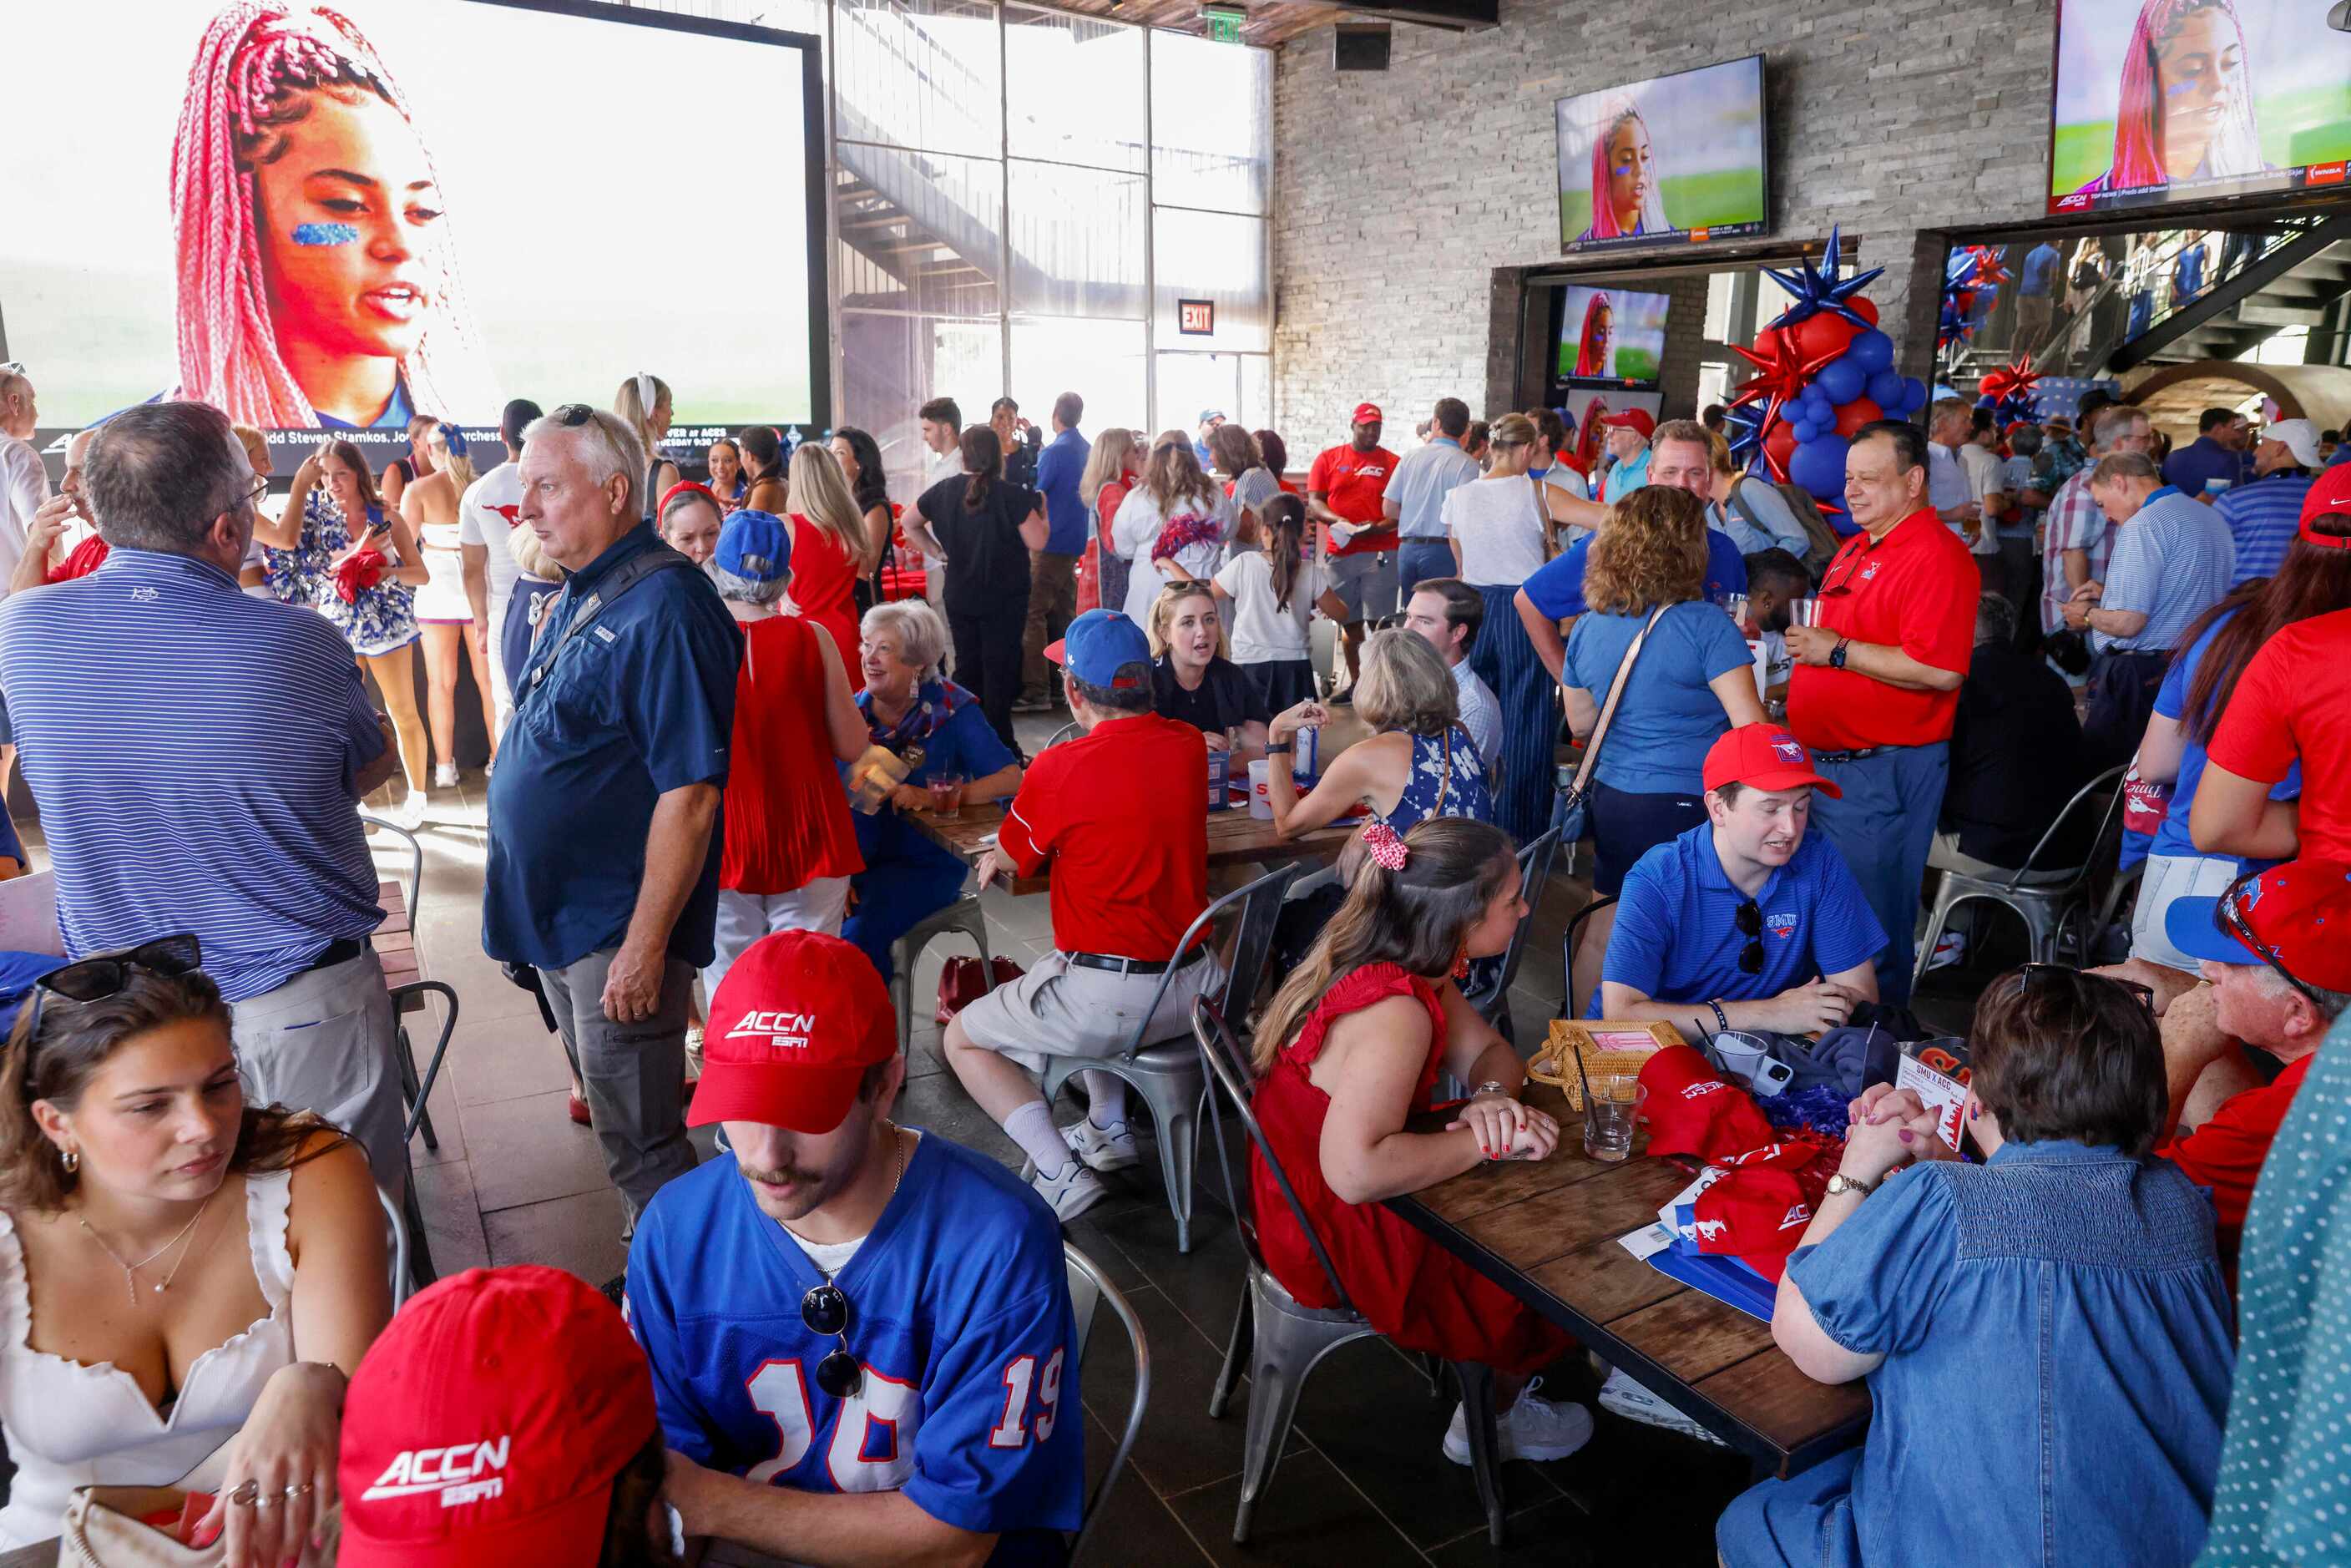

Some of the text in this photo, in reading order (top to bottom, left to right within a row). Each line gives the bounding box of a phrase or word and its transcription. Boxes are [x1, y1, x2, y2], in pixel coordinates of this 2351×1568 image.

[1182, 306, 1210, 330] EXIT
[267, 431, 286, 444] dd
[288, 431, 331, 444] Steven
[334, 430, 391, 444] Stamkos,
[666, 427, 687, 438] VER
[1766, 913, 1797, 928] SMU
[724, 1010, 816, 1039] ACCN
[1916, 1065, 1931, 1080] SMU
[1937, 1076, 1951, 1090] ACC
[988, 1346, 1064, 1449] 19
[361, 1435, 510, 1501] ACCN
